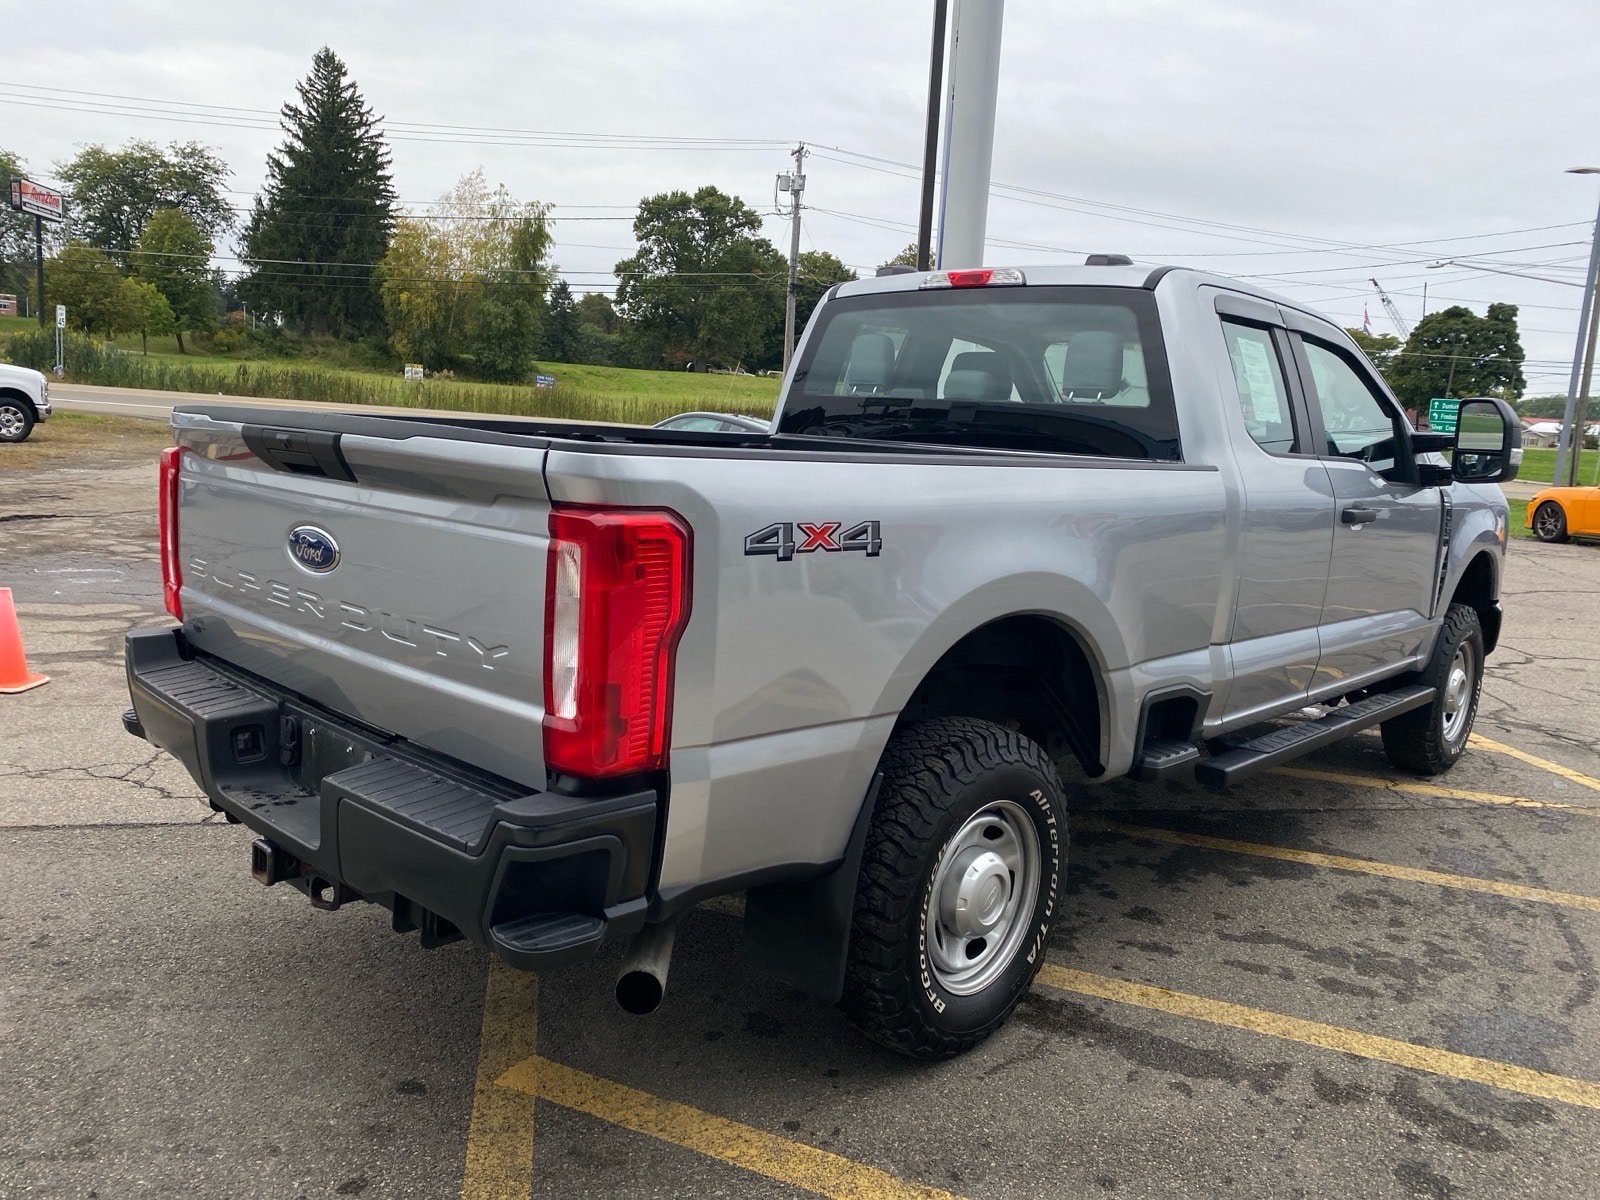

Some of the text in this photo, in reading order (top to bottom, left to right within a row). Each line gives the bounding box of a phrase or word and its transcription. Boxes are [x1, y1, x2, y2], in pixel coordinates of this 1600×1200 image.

[30, 186, 60, 208] AutoZone
[1442, 402, 1459, 410] Dunkir
[1445, 424, 1456, 432] Cree
[295, 534, 323, 563] Ford
[190, 555, 508, 670] SUPER DUTY
[1026, 788, 1059, 965] All-Terrain T/A
